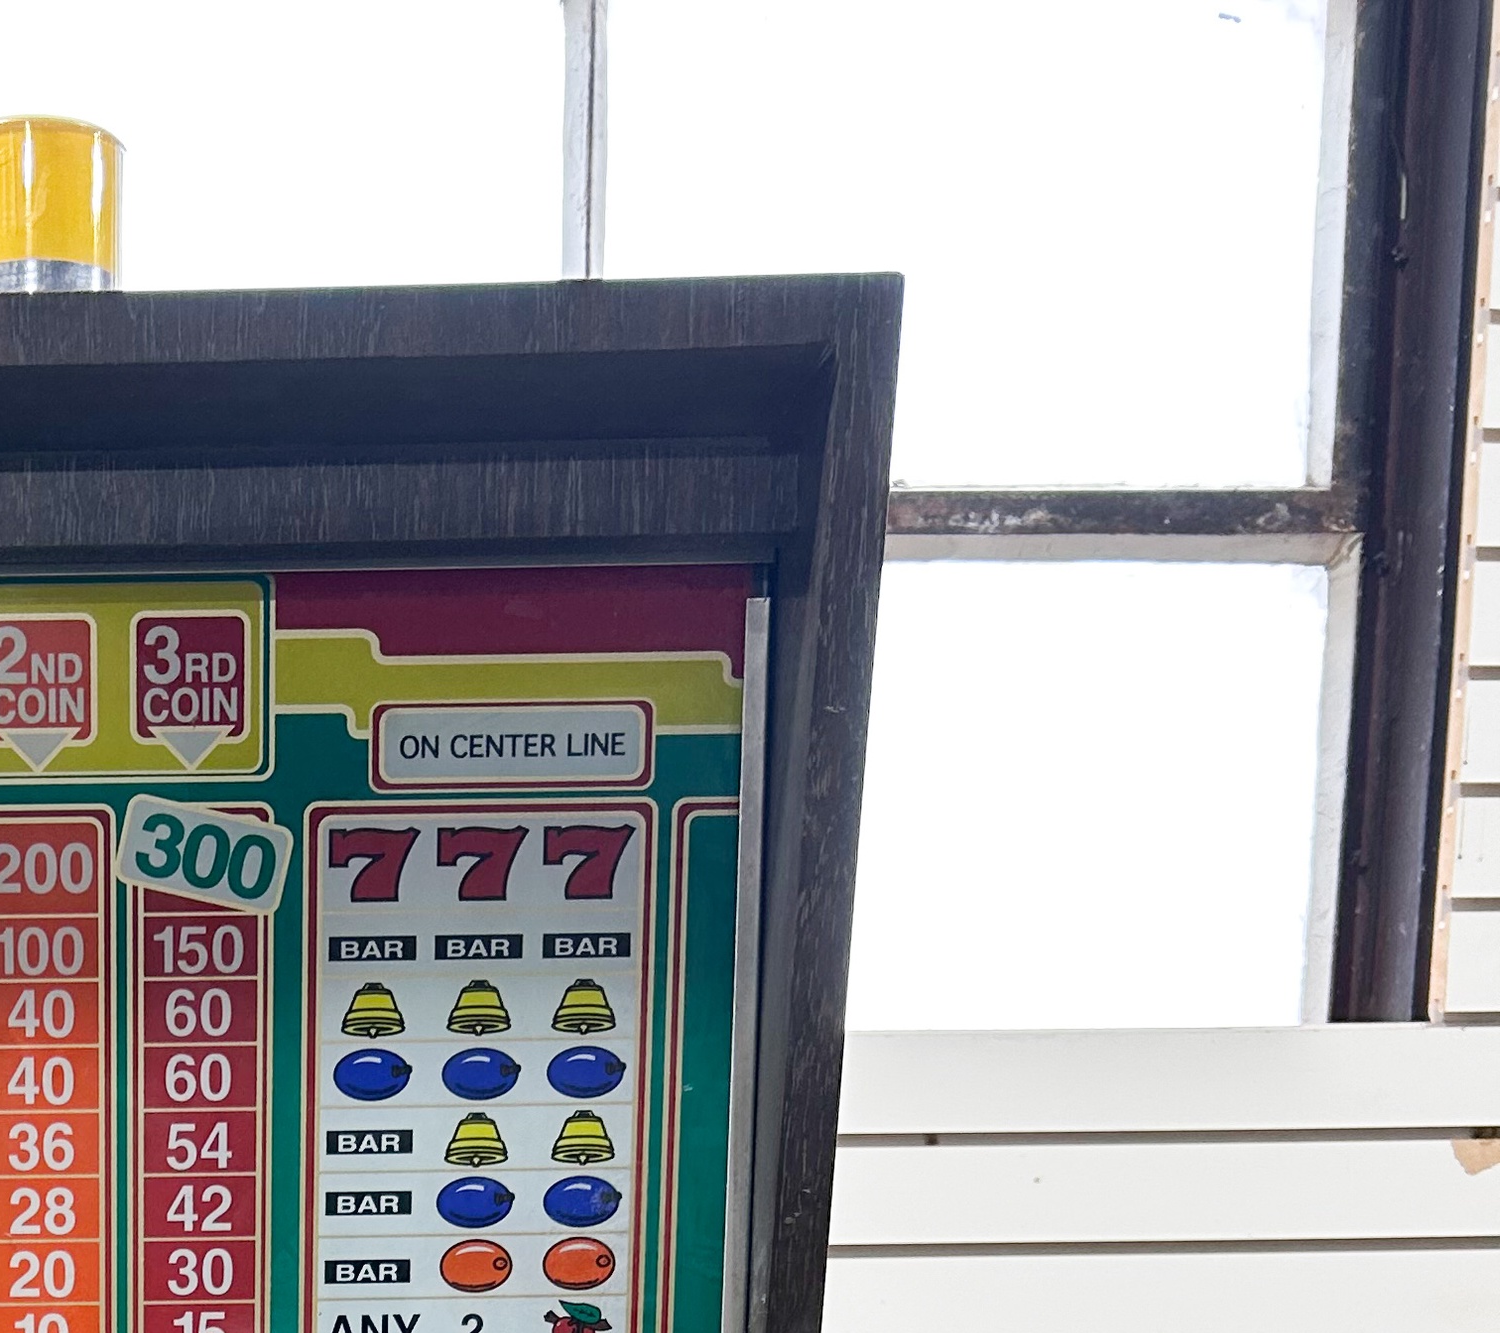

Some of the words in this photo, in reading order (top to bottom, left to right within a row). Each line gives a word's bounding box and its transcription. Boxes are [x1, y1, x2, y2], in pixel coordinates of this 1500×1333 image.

[143, 625, 237, 684] 3RD
[143, 687, 238, 723] COIN
[400, 735, 440, 759] ON
[451, 734, 555, 758] CENTER
[567, 732, 626, 757] LINE
[135, 812, 276, 900] 300
[153, 924, 245, 974] 150
[340, 940, 405, 959] BAR
[446, 939, 510, 957] BAR
[554, 937, 618, 956] BAR
[7, 989, 75, 1038] 40
[165, 988, 232, 1036] 60
[7, 1057, 74, 1105] 40
[165, 1053, 232, 1102] 60
[8, 1122, 75, 1171] 36
[167, 1121, 232, 1170] 54
[338, 1133, 400, 1152] BAR
[9, 1187, 76, 1235] 28
[167, 1185, 232, 1232] 42
[337, 1195, 400, 1213] BAR
[9, 1250, 75, 1298] 20
[168, 1248, 234, 1296] 30
[335, 1263, 398, 1282] BAR
